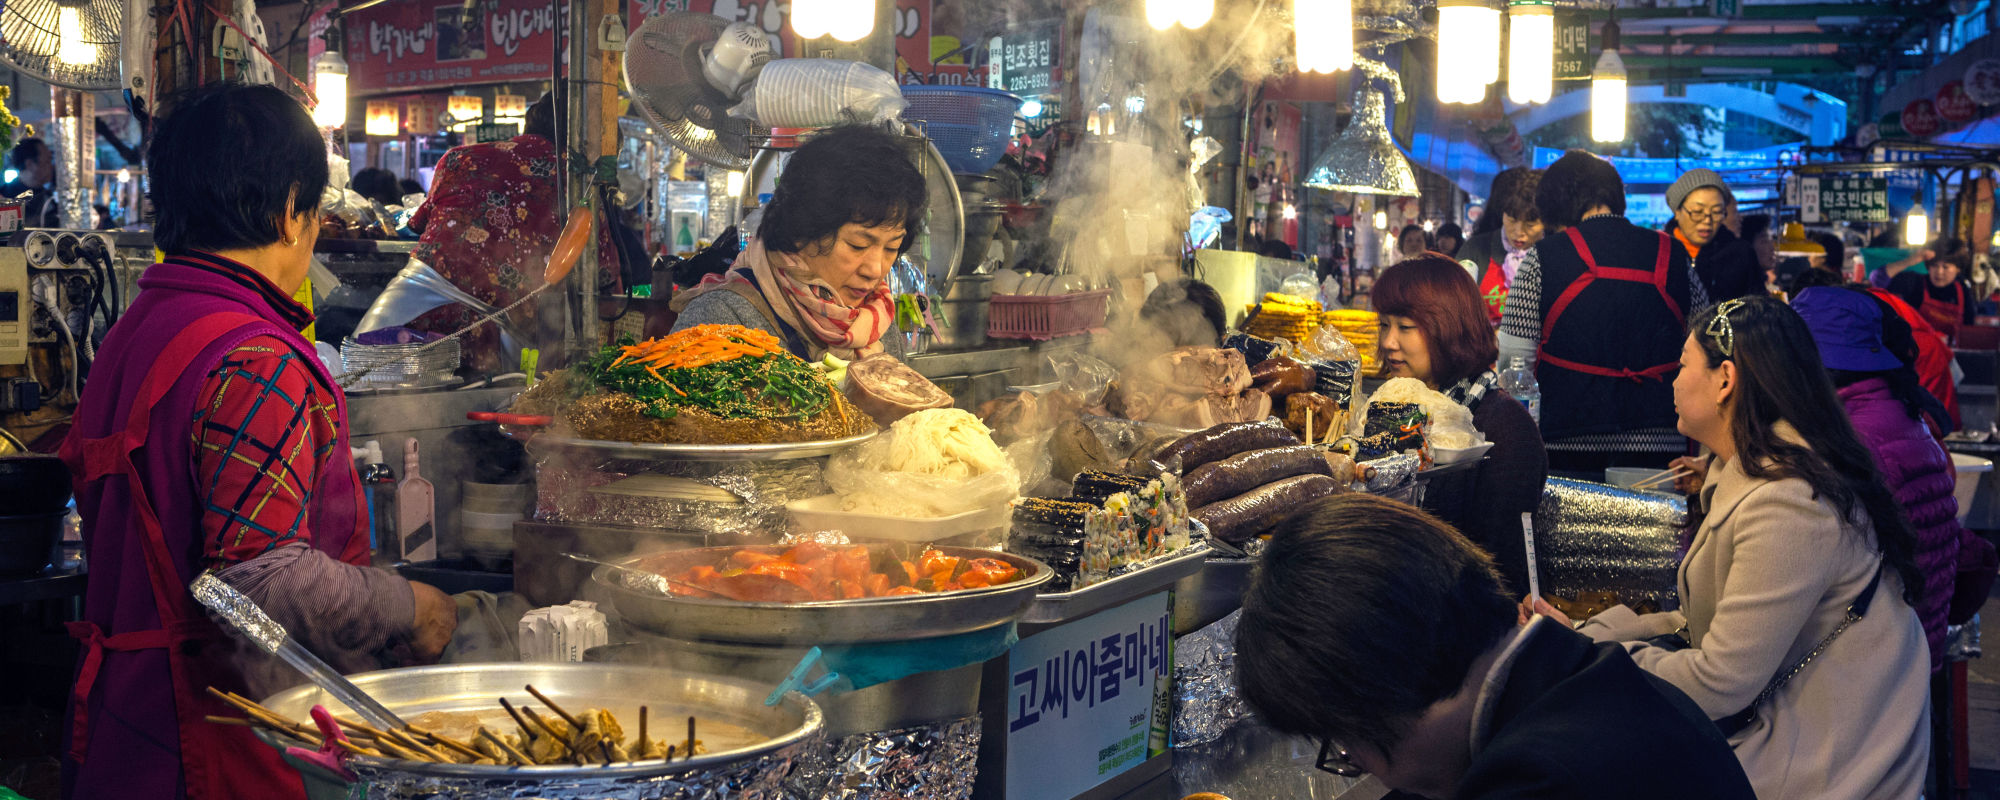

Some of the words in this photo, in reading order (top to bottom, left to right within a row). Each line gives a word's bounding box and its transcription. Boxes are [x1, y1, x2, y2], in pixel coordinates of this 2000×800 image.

[370, 20, 433, 64] 박가네
[1004, 38, 1050, 71] 원조횟집
[992, 62, 1000, 75] 61
[1010, 613, 1168, 733] 고씨아줌마네
